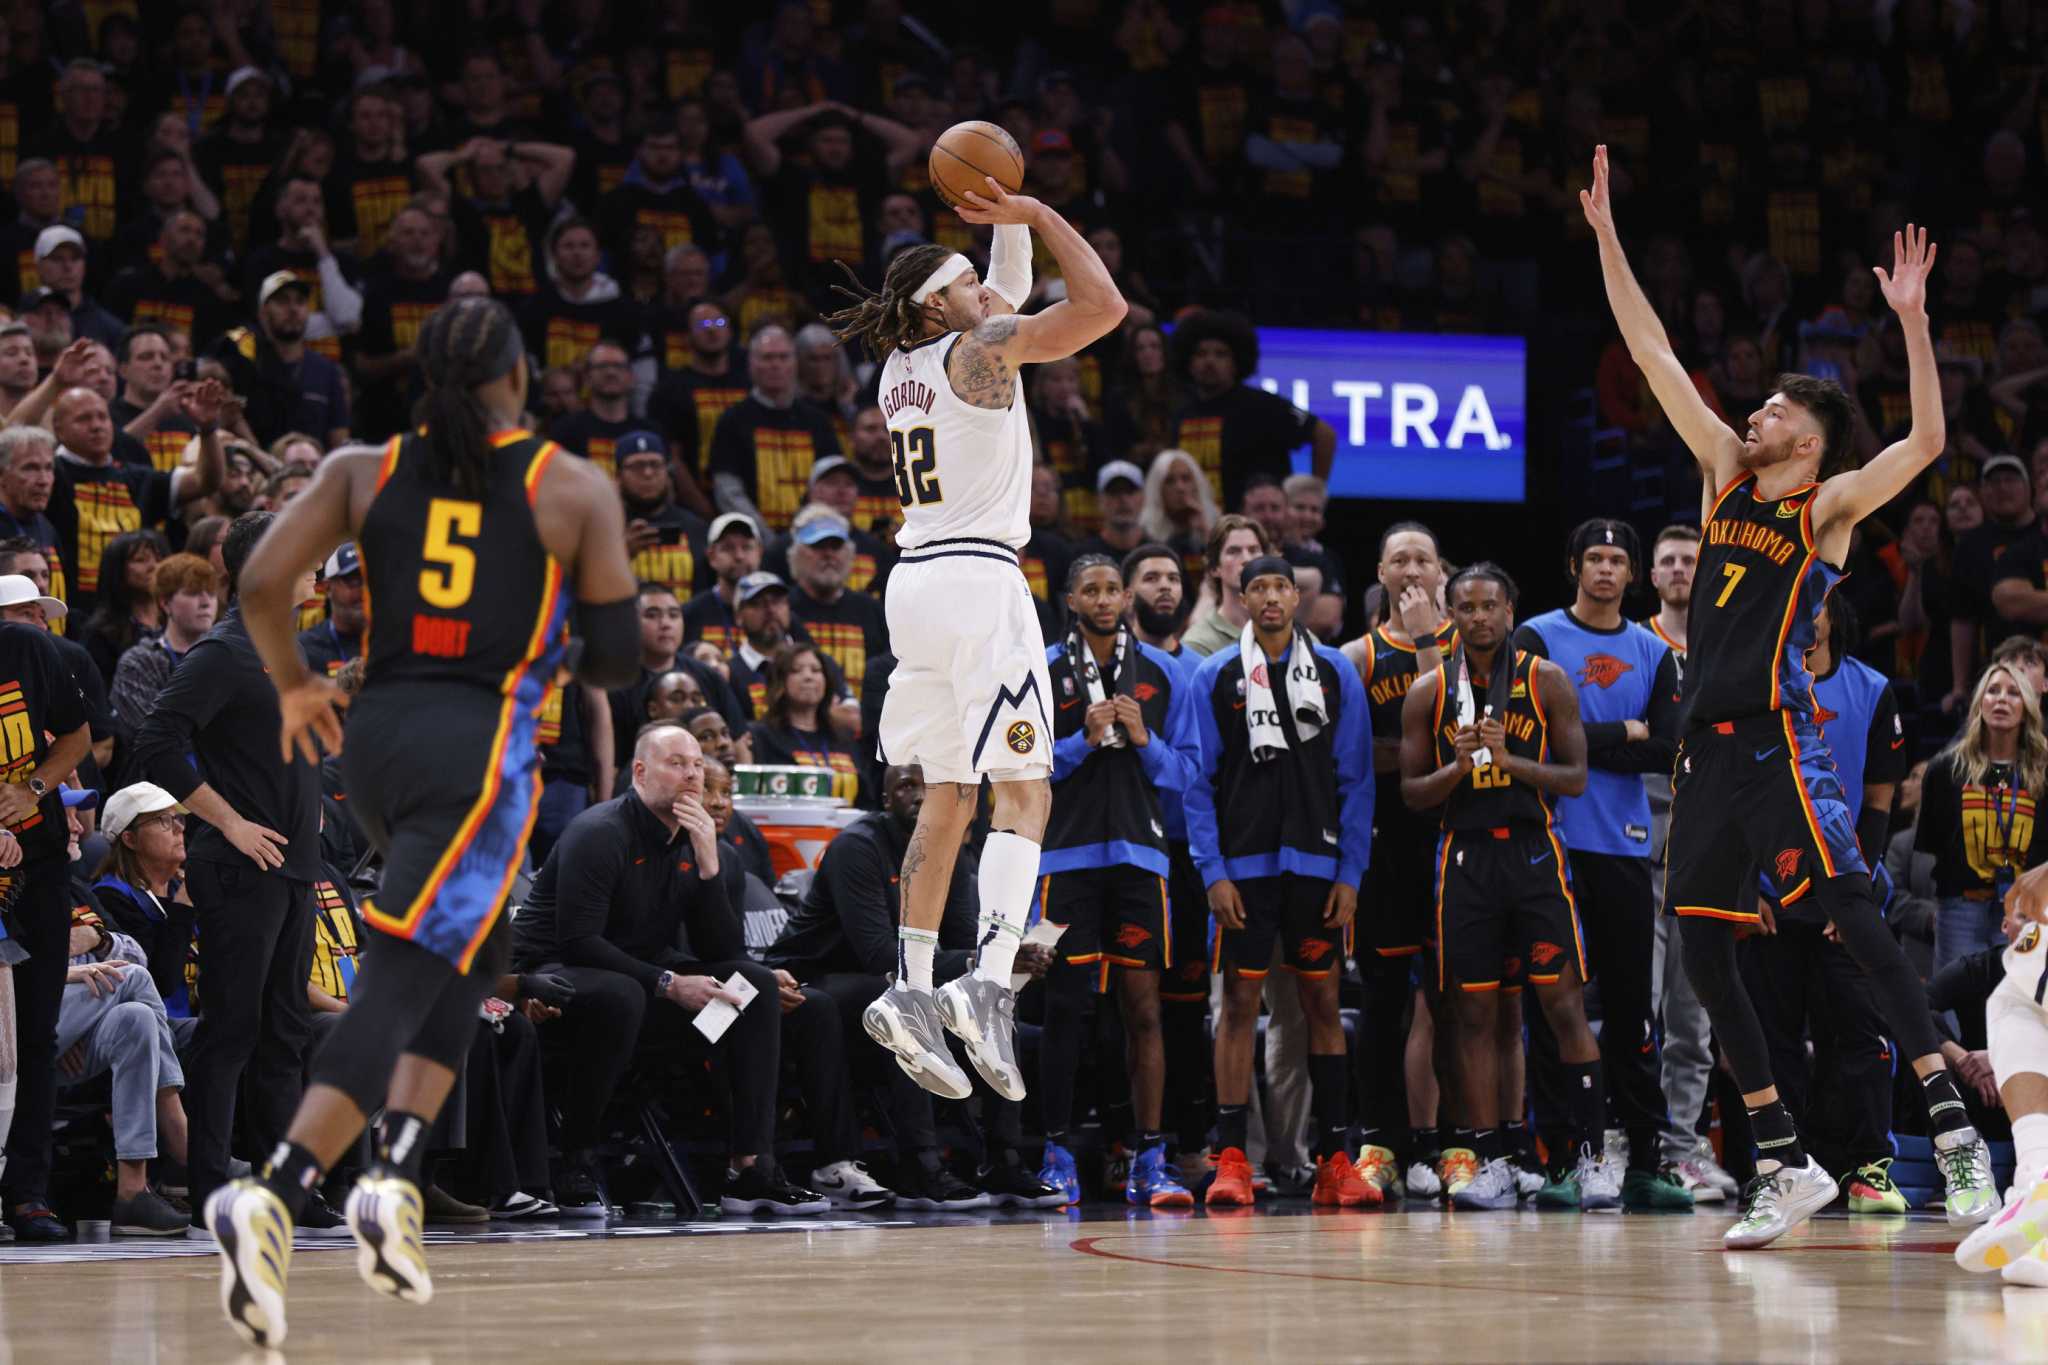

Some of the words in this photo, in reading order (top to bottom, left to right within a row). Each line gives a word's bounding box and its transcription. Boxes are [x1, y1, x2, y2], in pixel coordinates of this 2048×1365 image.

[883, 379, 937, 419] GORDON
[889, 425, 945, 509] 32
[418, 497, 483, 609] 5
[1709, 520, 1796, 566] OKLHOMA
[1714, 561, 1747, 608] 7
